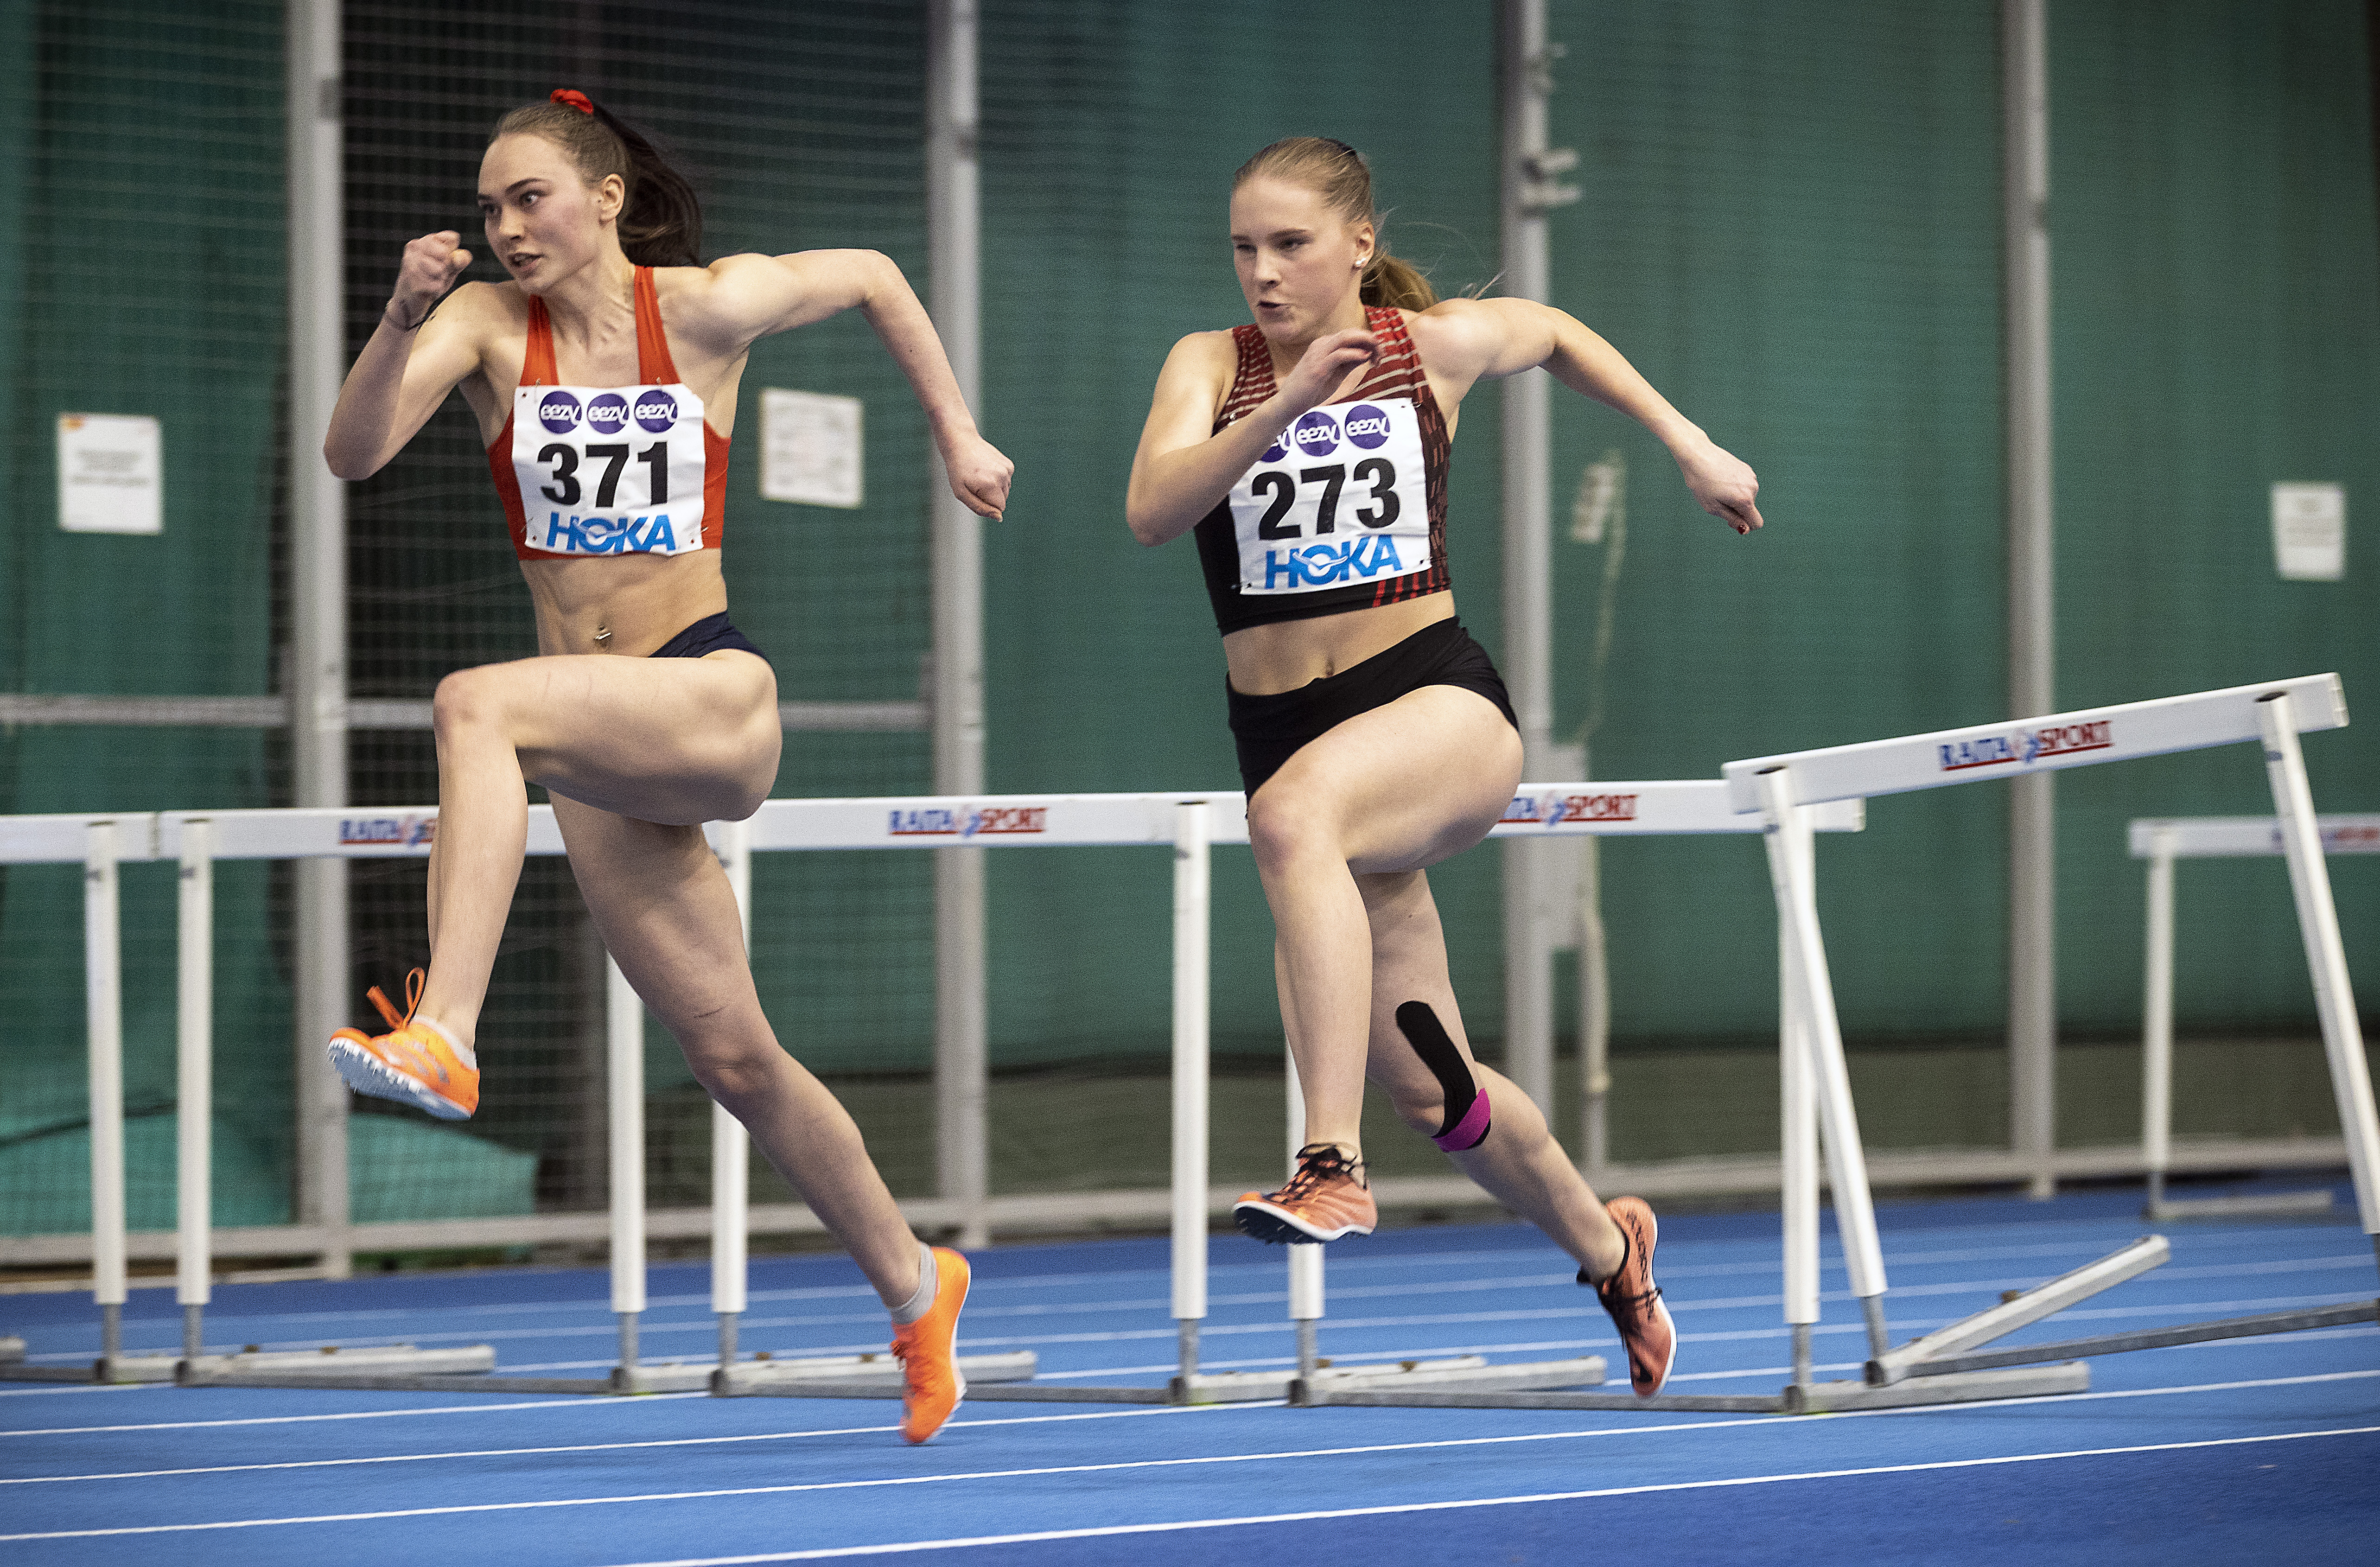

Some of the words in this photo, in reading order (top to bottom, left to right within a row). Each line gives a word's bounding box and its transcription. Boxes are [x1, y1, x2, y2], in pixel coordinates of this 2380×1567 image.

[541, 403, 581, 425] eezy
[587, 404, 629, 425] eezy
[635, 401, 677, 424] eezy
[1296, 424, 1340, 445] eezy
[1345, 417, 1390, 437] eezy
[537, 441, 669, 508] 371
[1251, 457, 1401, 541] 273
[546, 511, 676, 554] HOKA
[1265, 534, 1403, 590] HOKA
[2036, 720, 2112, 751] SPORT
